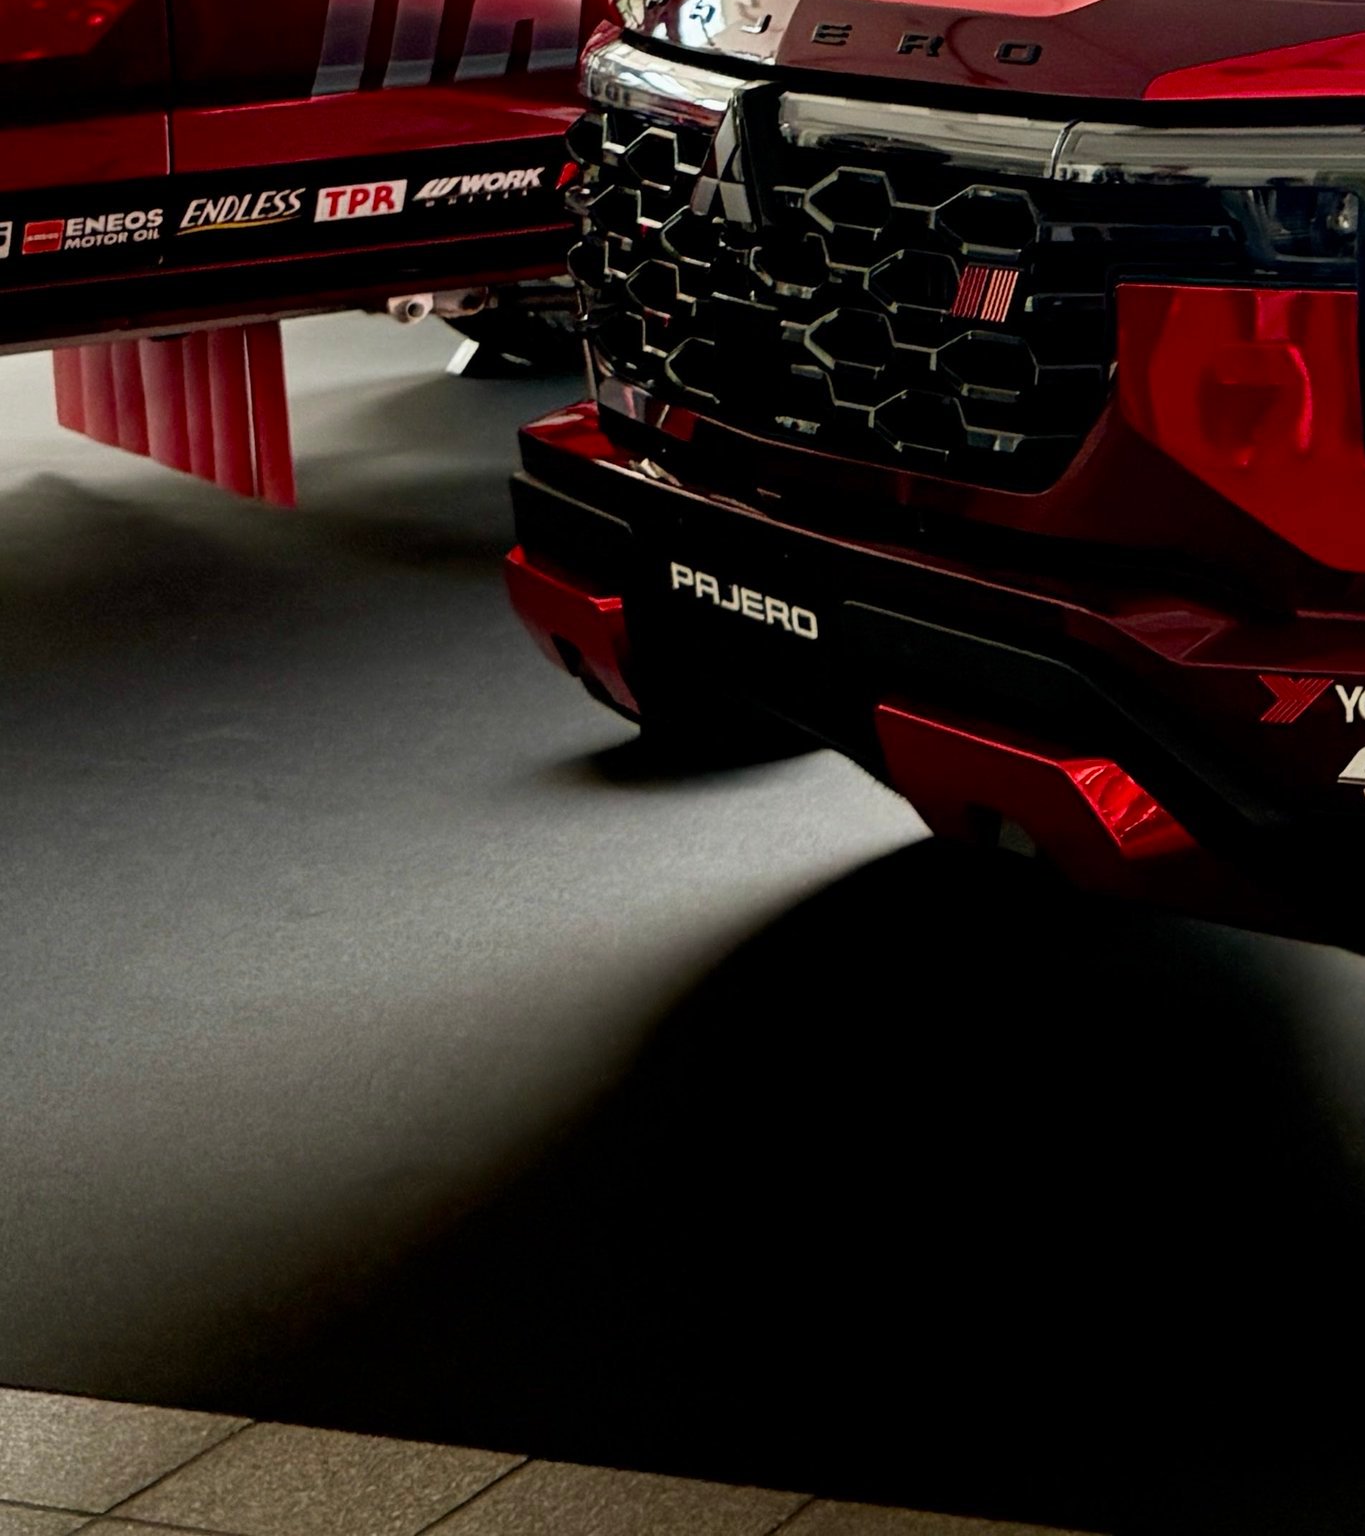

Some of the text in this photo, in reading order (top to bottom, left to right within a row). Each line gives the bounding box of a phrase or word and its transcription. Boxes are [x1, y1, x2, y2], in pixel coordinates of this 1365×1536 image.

[459, 167, 545, 195] WORK
[179, 187, 306, 229] ENDLESS
[325, 185, 394, 218] TPR
[65, 208, 163, 237] ENEOS
[64, 231, 128, 250] MOTOR
[132, 228, 161, 242] OIL
[671, 562, 818, 640] PAJERO
